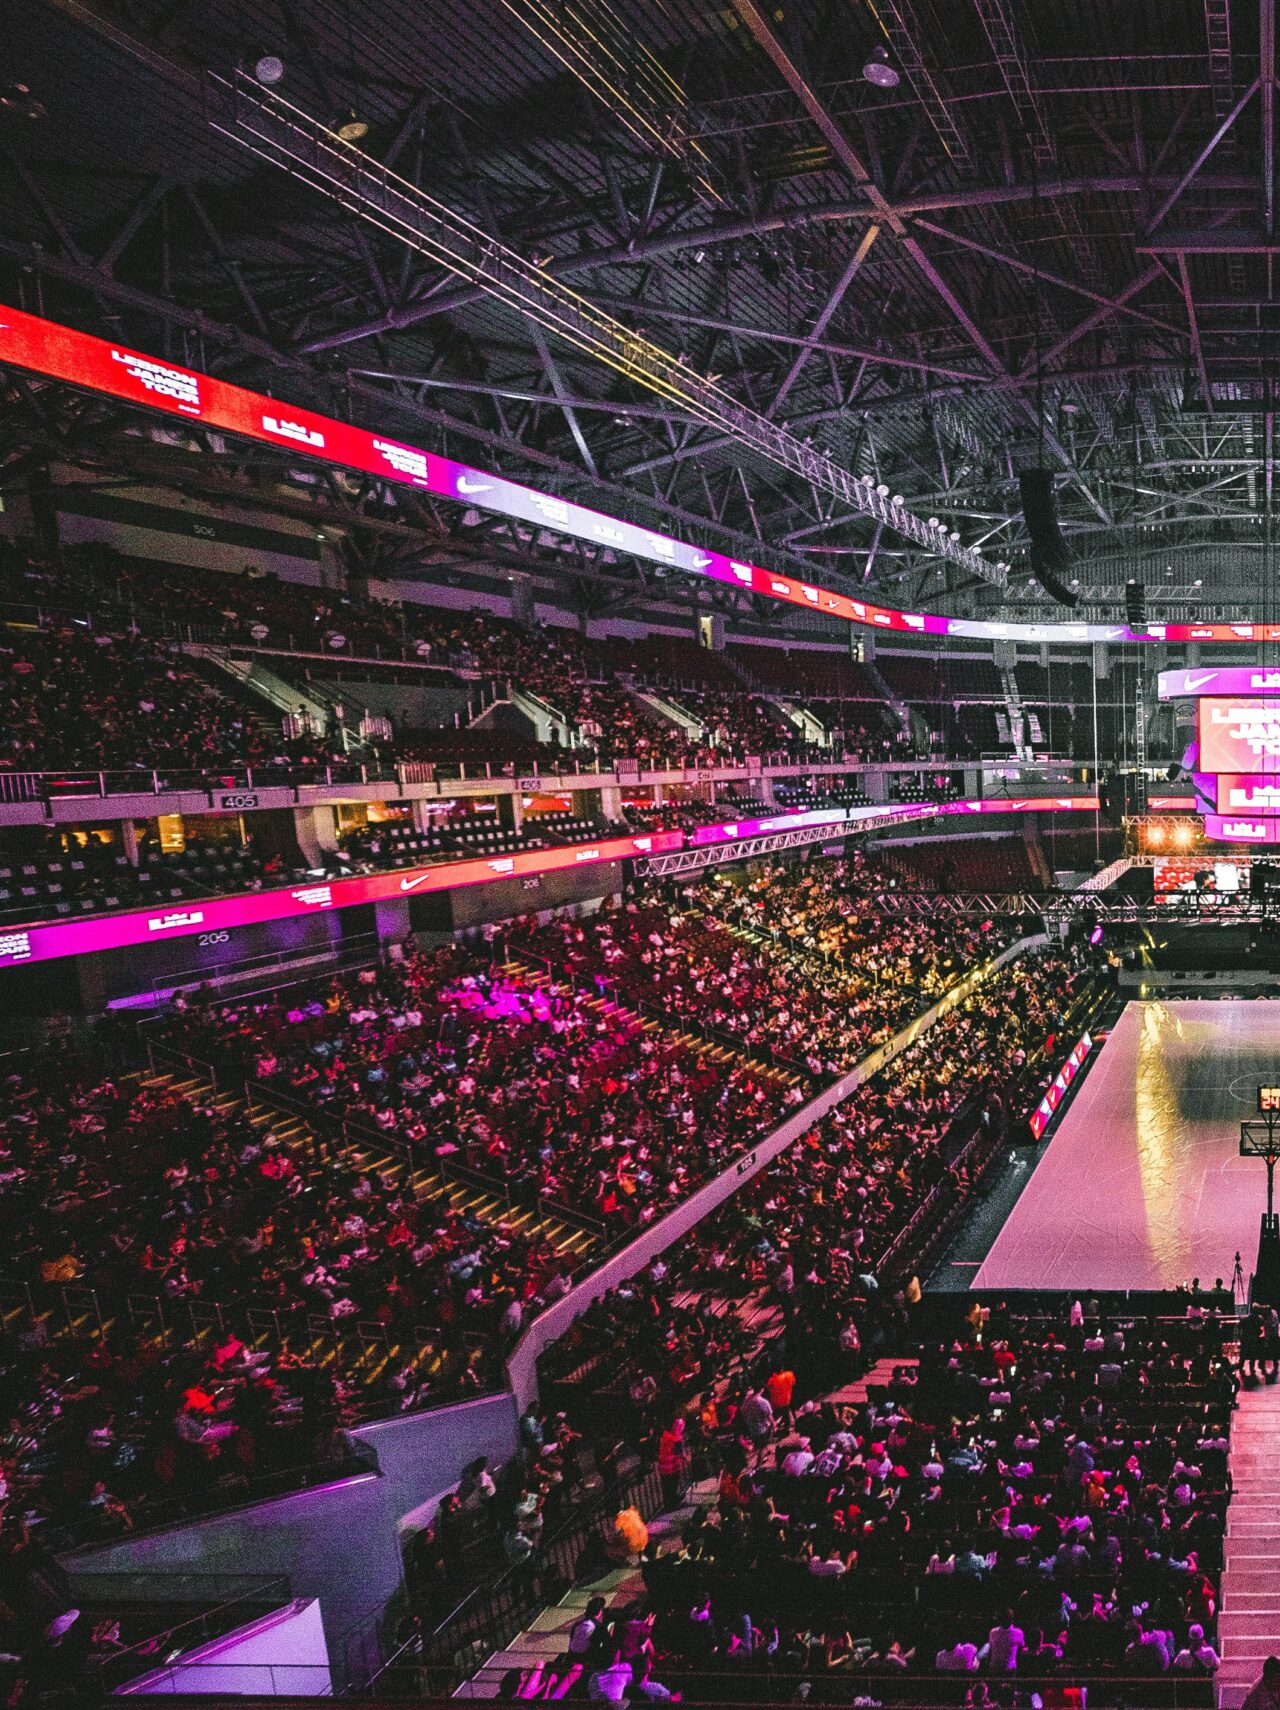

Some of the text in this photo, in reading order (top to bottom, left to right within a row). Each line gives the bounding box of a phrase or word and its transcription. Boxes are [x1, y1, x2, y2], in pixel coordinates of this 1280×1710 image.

[193, 524, 216, 537] 506
[225, 795, 255, 808] 405
[199, 930, 230, 946] 205
[1262, 1096, 1280, 1110] 24
